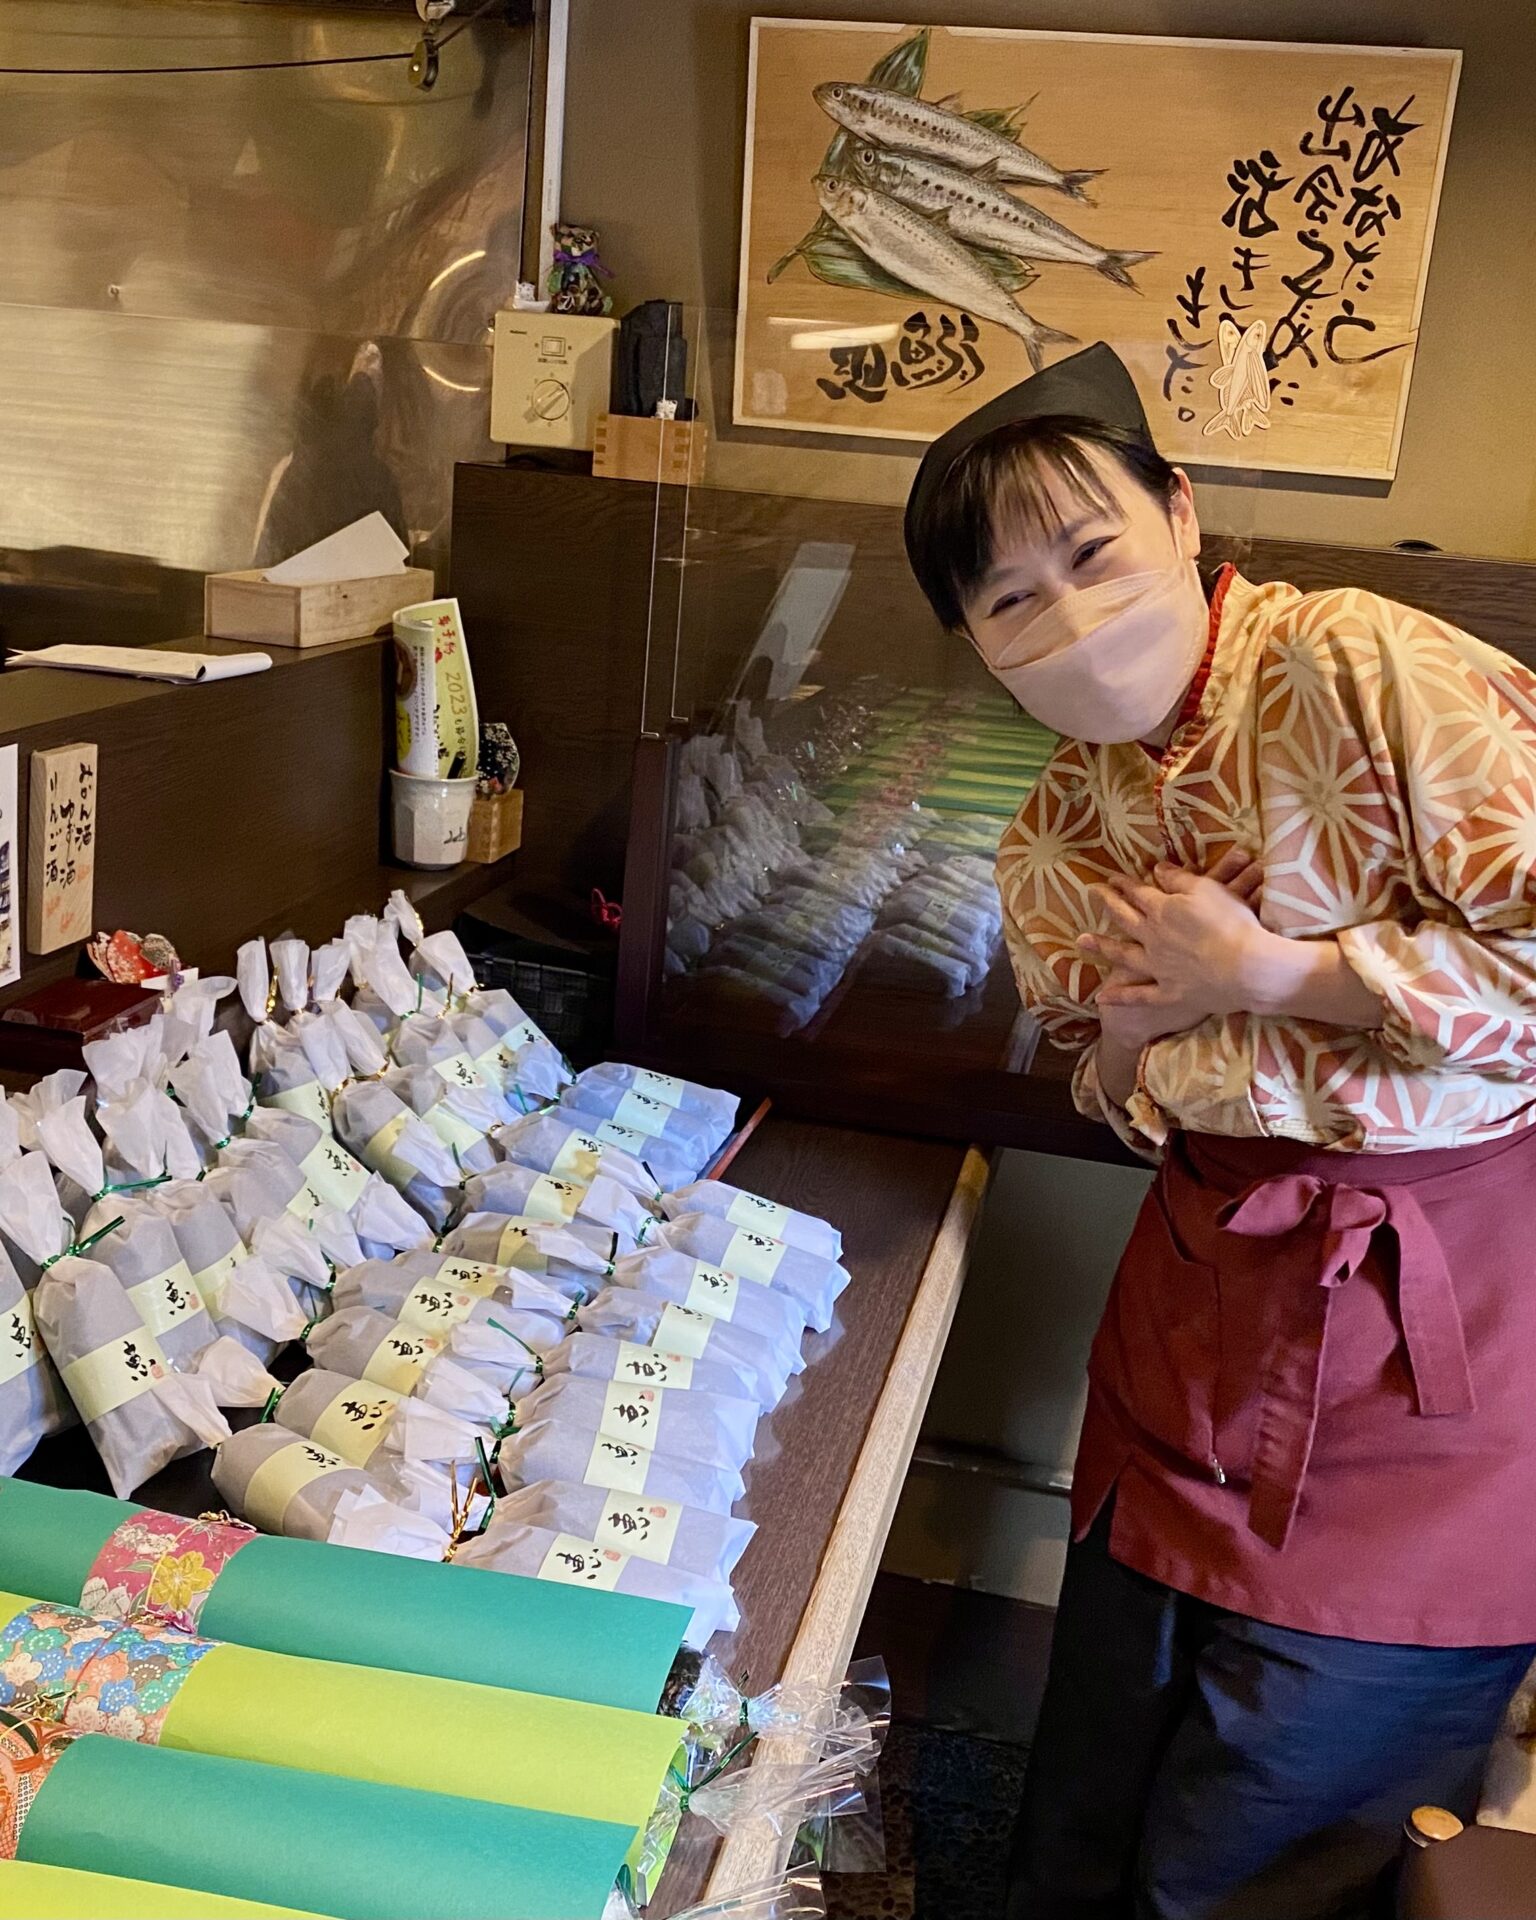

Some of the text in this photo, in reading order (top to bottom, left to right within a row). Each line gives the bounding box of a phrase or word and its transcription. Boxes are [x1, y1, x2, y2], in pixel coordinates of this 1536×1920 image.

[445, 671, 468, 716] 2023
[45, 771, 63, 889] りんご酒
[75, 762, 94, 852] みかん酒
